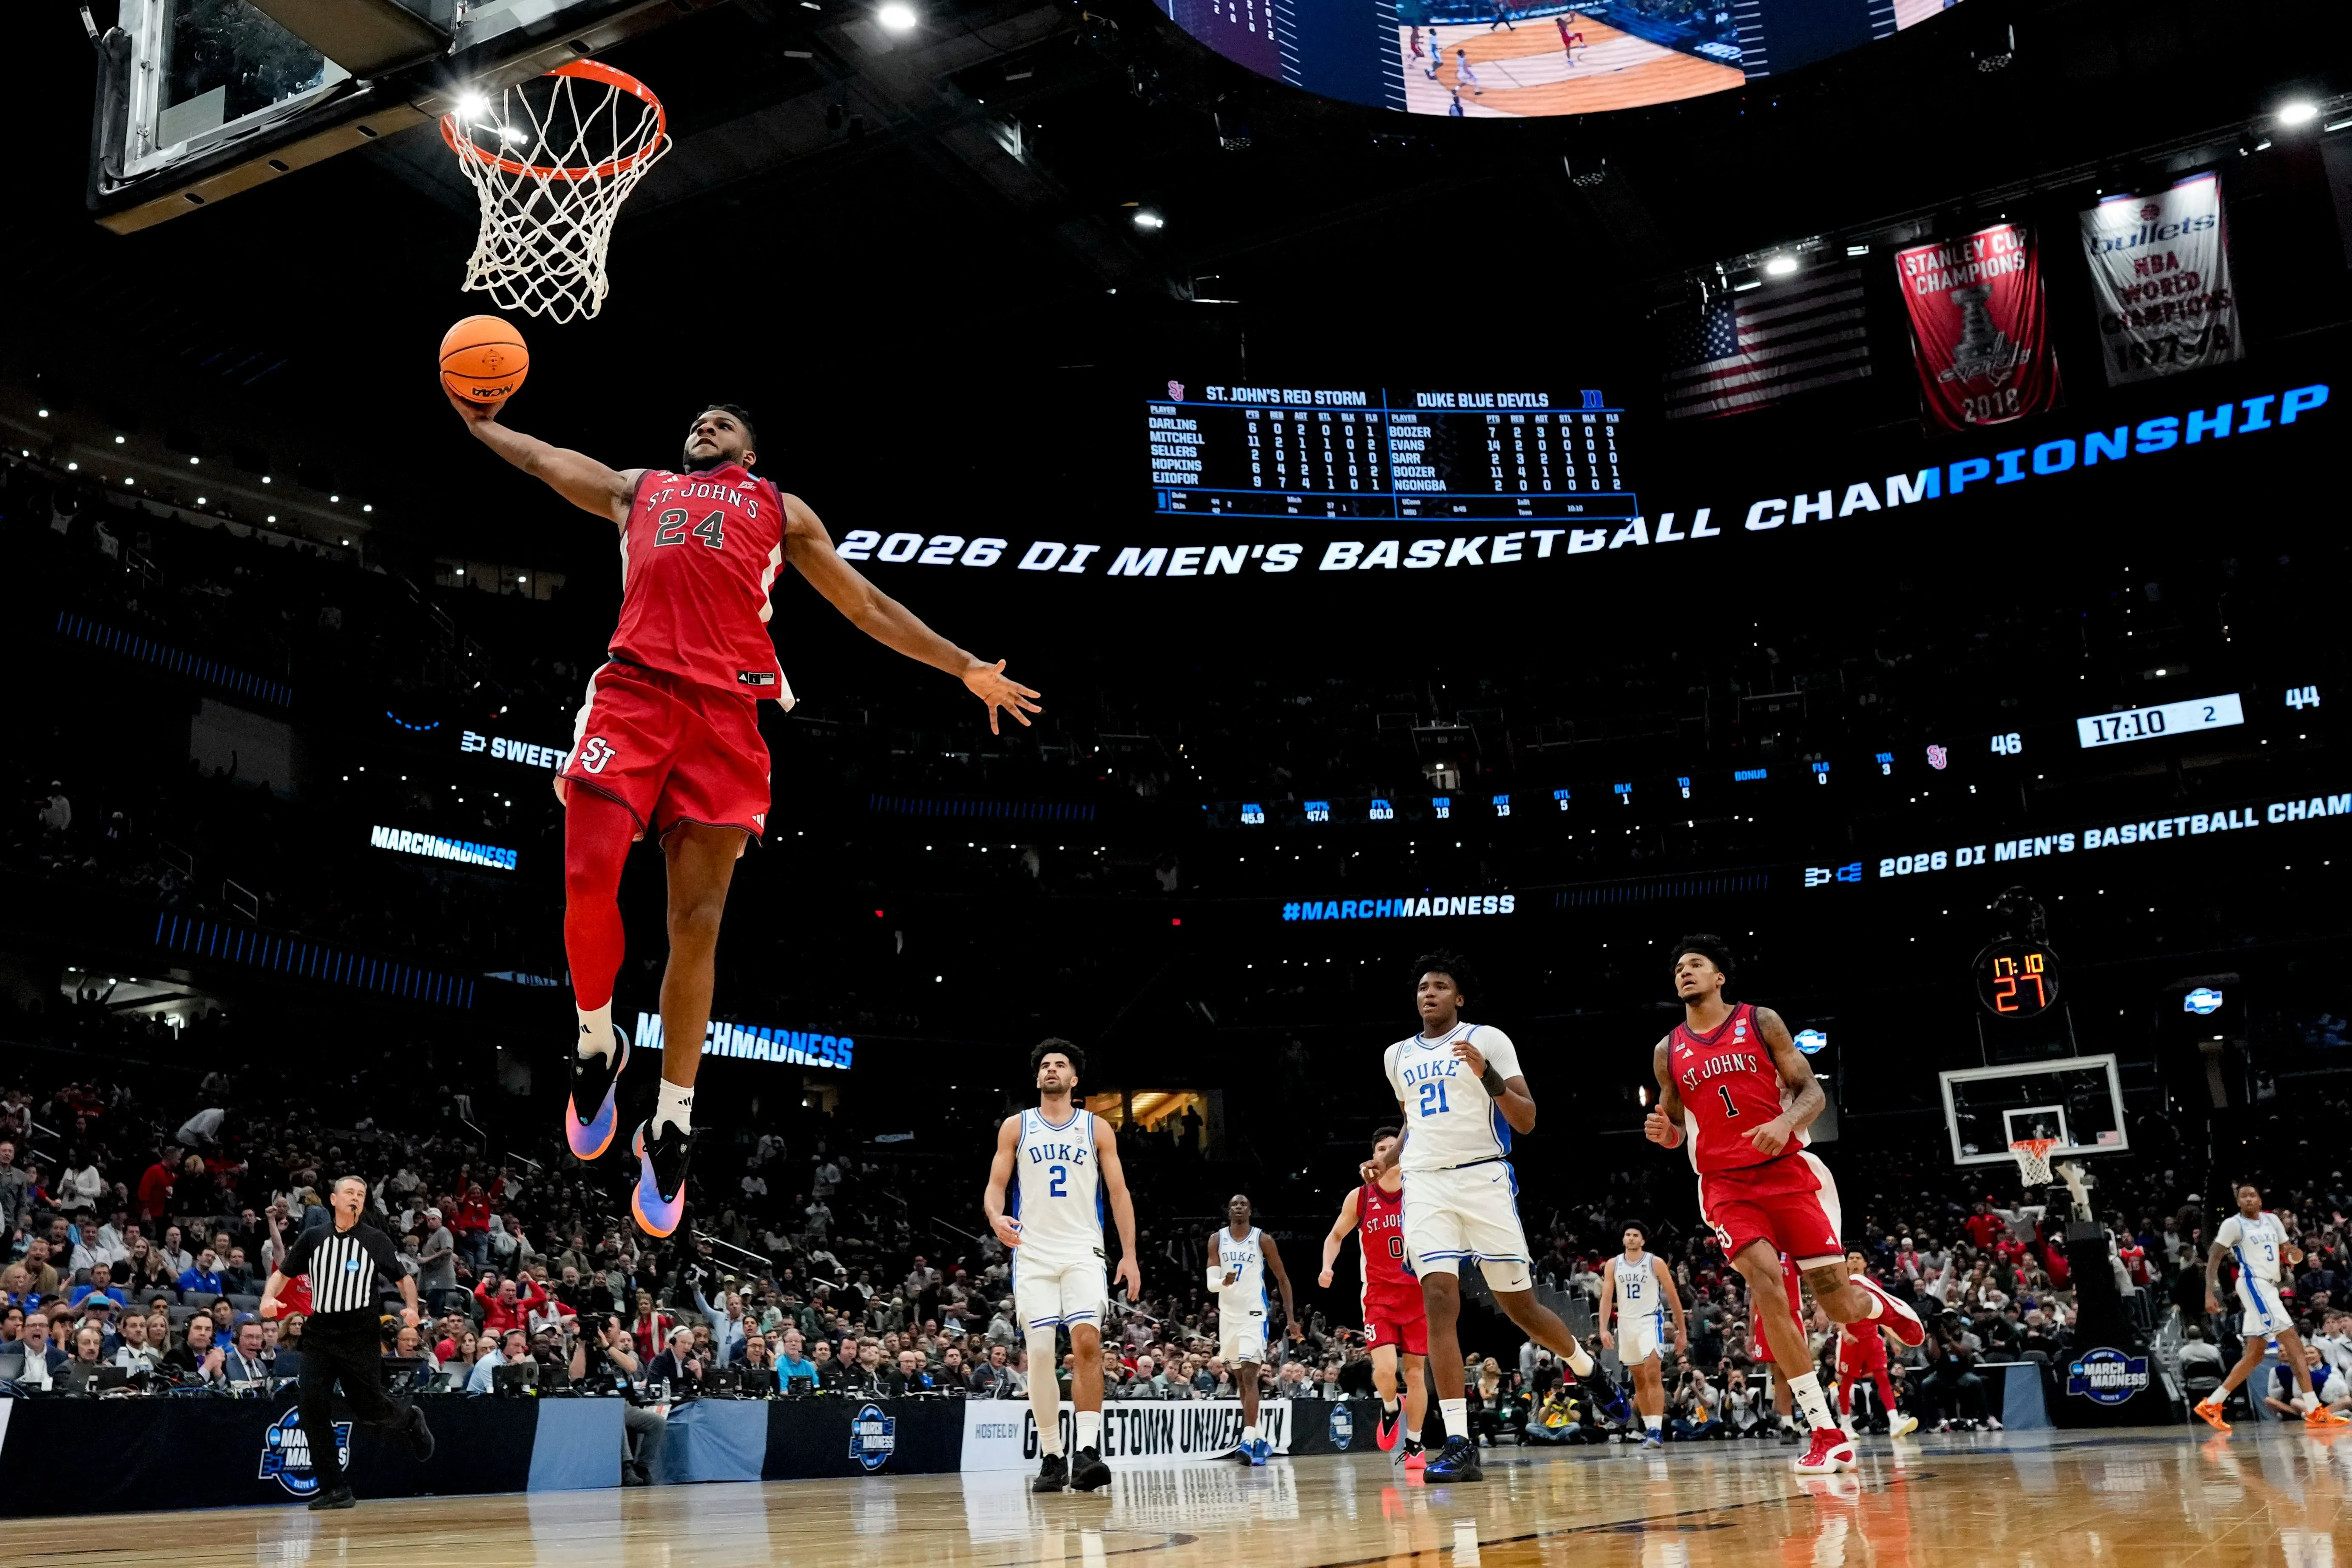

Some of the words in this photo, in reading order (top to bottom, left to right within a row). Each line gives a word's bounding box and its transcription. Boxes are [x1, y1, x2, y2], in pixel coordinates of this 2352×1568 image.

[2092, 214, 2215, 254] bullets
[1906, 238, 1986, 277] STANLEY
[1992, 229, 2027, 253] CUP
[1916, 250, 2025, 295] CHAMPIONS
[2134, 251, 2179, 278] NBA
[2122, 271, 2200, 305] WORLD
[472, 383, 513, 396] NCAA
[1207, 386, 1227, 401] ST.
[1230, 387, 1280, 403] JOHN'S
[1283, 389, 1311, 404] RED
[1315, 391, 1366, 405] STORM
[1417, 393, 1455, 407] DUKE
[1458, 393, 1494, 407] BLUE
[1497, 393, 1548, 407] DEVILS
[1962, 388, 2020, 423] 2018
[1149, 418, 1196, 430] DARLING
[1249, 423, 1256, 433] 6
[1274, 423, 1281, 434] 0
[1298, 424, 1305, 435] 2
[1322, 425, 1330, 435] 0
[1345, 426, 1353, 436] 0
[1367, 426, 1373, 436] 1
[1389, 426, 1431, 437] BOOZER
[1488, 427, 1495, 437] 7
[1514, 427, 1521, 437] 2
[1562, 426, 1569, 437] 0
[1585, 426, 1593, 437] 0
[1150, 431, 1204, 444] MITCHELL
[1248, 436, 1260, 446] 11
[1275, 437, 1283, 447] 2
[1299, 437, 1306, 448] 1
[1324, 438, 1330, 449] 1
[1346, 439, 1354, 449] 0
[1368, 439, 1375, 450] 2
[1390, 440, 1425, 450] EVANS
[1488, 440, 1500, 451] 14
[1515, 440, 1523, 451] 2
[1539, 440, 1546, 451] 0
[1564, 440, 1571, 450] 0
[1587, 440, 1594, 450] 0
[1608, 439, 1615, 450] 1
[1151, 445, 1197, 457] SELLERS
[1252, 449, 1259, 460] 2
[1276, 450, 1284, 461] 0
[1301, 451, 1307, 461] 1
[1325, 452, 1332, 462] 0
[1349, 452, 1355, 463] 1
[1369, 452, 1377, 463] 0
[1392, 453, 1420, 463] SARR
[1492, 454, 1499, 464] 2
[1540, 453, 1548, 464] 2
[1566, 453, 1572, 464] 1
[1588, 453, 1596, 463] 0
[1610, 452, 1617, 463] 0
[1152, 458, 1202, 471] HOPKINS
[1253, 463, 1260, 473] 6
[1278, 463, 1285, 474] 4
[1301, 464, 1309, 475] 2
[1327, 465, 1333, 476] 1
[1349, 465, 1357, 476] 0
[1370, 466, 1378, 476] 2
[1393, 466, 1435, 477] BOOZER
[1491, 467, 1503, 477] 11
[1518, 467, 1525, 477] 4
[1542, 466, 1549, 477] 1
[1567, 466, 1574, 477] 0
[1591, 466, 1597, 477] 1
[1612, 466, 1619, 476] 1
[835, 530, 1008, 571] 2026
[1018, 542, 1100, 573] DI
[1107, 544, 1303, 576] MEN'S
[1319, 503, 1720, 570] BASKETBALL
[1744, 386, 2328, 531] CHAMPIONSHIP
[1153, 472, 1198, 484] EJIOFOR
[1279, 477, 1286, 488] 7
[1302, 478, 1310, 489] 4
[1328, 478, 1334, 489] 1
[1350, 479, 1358, 489] 0
[1372, 479, 1379, 490] 1
[1395, 480, 1446, 491] NGONGBA
[1495, 480, 1502, 491] 2
[1520, 480, 1527, 491] 0
[1543, 480, 1551, 490] 0
[1568, 480, 1576, 490] 0
[1592, 479, 1599, 490] 0
[1613, 479, 1621, 489] 2
[647, 489, 675, 511] ST.
[681, 483, 758, 518] JOHN'S
[654, 508, 724, 549] 24
[2286, 686, 2320, 709] 44
[2093, 710, 2165, 743] 17:10
[2203, 706, 2216, 723] 2
[1991, 733, 2022, 755] 46
[491, 737, 568, 770] SWEET
[1677, 777, 1690, 787] TO
[1735, 769, 1767, 781] BONUS
[1818, 773, 1826, 784] 0
[1623, 794, 1630, 804] 1
[1682, 788, 1690, 798] 5
[1497, 805, 1510, 816] 13
[1560, 800, 1568, 810] 5
[1241, 813, 1264, 824] 45.9
[1307, 811, 1328, 822] 47.4
[371, 826, 517, 870] MARCHMADNESS
[1880, 851, 1947, 877] 2026
[1956, 846, 1986, 867] DI
[1995, 833, 2074, 861] MEN'S
[2084, 808, 2258, 849] BASKETBALL
[1282, 895, 1515, 921] #MARCHMADNESS
[1994, 954, 2044, 977] 17:10
[1994, 974, 2045, 1011] 27
[635, 1011, 854, 1070] MCHMADNESS
[1403, 1060, 1459, 1087] DUKE
[1682, 1067, 1701, 1091] ST.
[1702, 1054, 1757, 1079] JOHN'S
[1420, 1079, 1449, 1117] 21
[1718, 1085, 1740, 1118] 1
[1029, 1144, 1087, 1165] DUKE
[1050, 1165, 1066, 1197] 2
[1366, 1218, 1380, 1233] ST.
[1388, 1236, 1403, 1259] 0
[2264, 1245, 2273, 1261] 3
[1222, 1252, 1255, 1263] DUKE
[1233, 1264, 1242, 1281] 7
[1618, 1273, 1648, 1283] DUKE
[1627, 1284, 1640, 1298] 12
[2084, 1362, 2125, 1375] MARCH
[2091, 1373, 2147, 1387] MADNESS
[975, 1423, 1007, 1439] HOSTED
[1008, 1423, 1019, 1437] BY
[1023, 1409, 1174, 1459] GOETOWN
[1180, 1408, 1284, 1454] UNIVERTY
